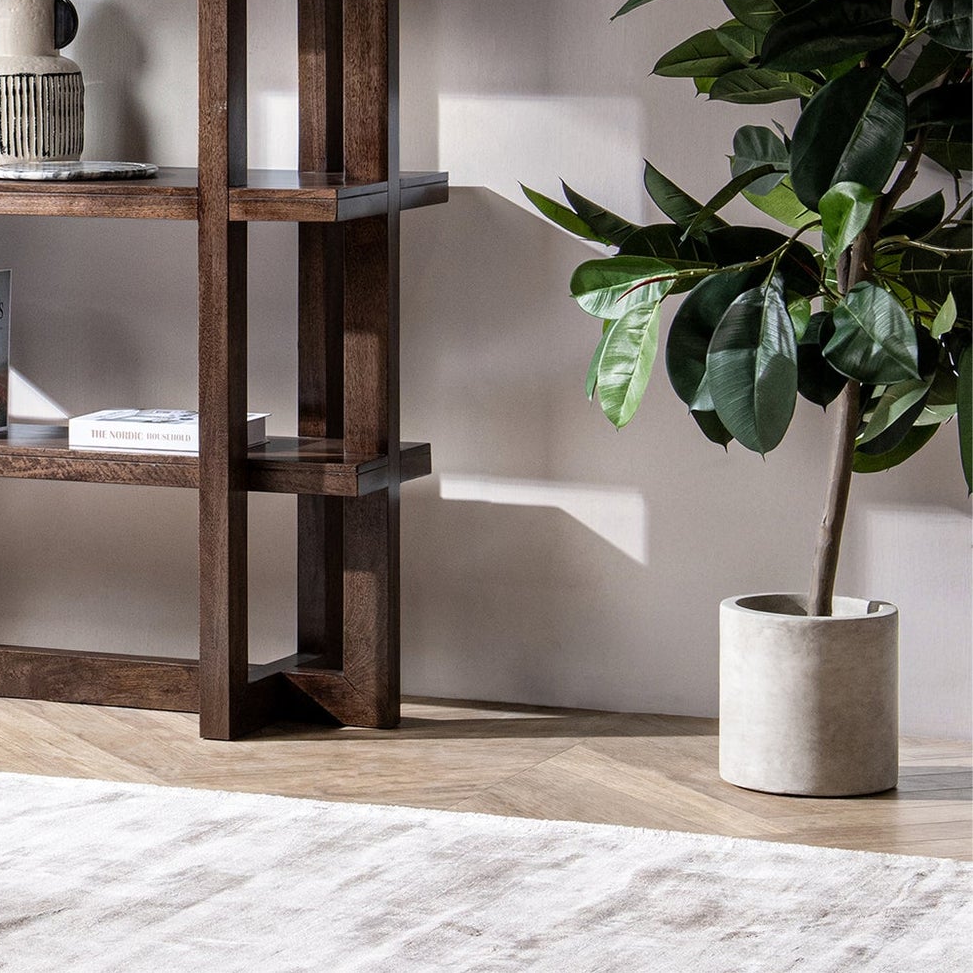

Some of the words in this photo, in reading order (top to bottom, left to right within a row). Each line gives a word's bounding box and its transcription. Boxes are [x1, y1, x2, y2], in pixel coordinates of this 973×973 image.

[91, 429, 106, 439] THE
[109, 430, 143, 440] NORDIC
[146, 432, 191, 442] HOUSEHOLD
